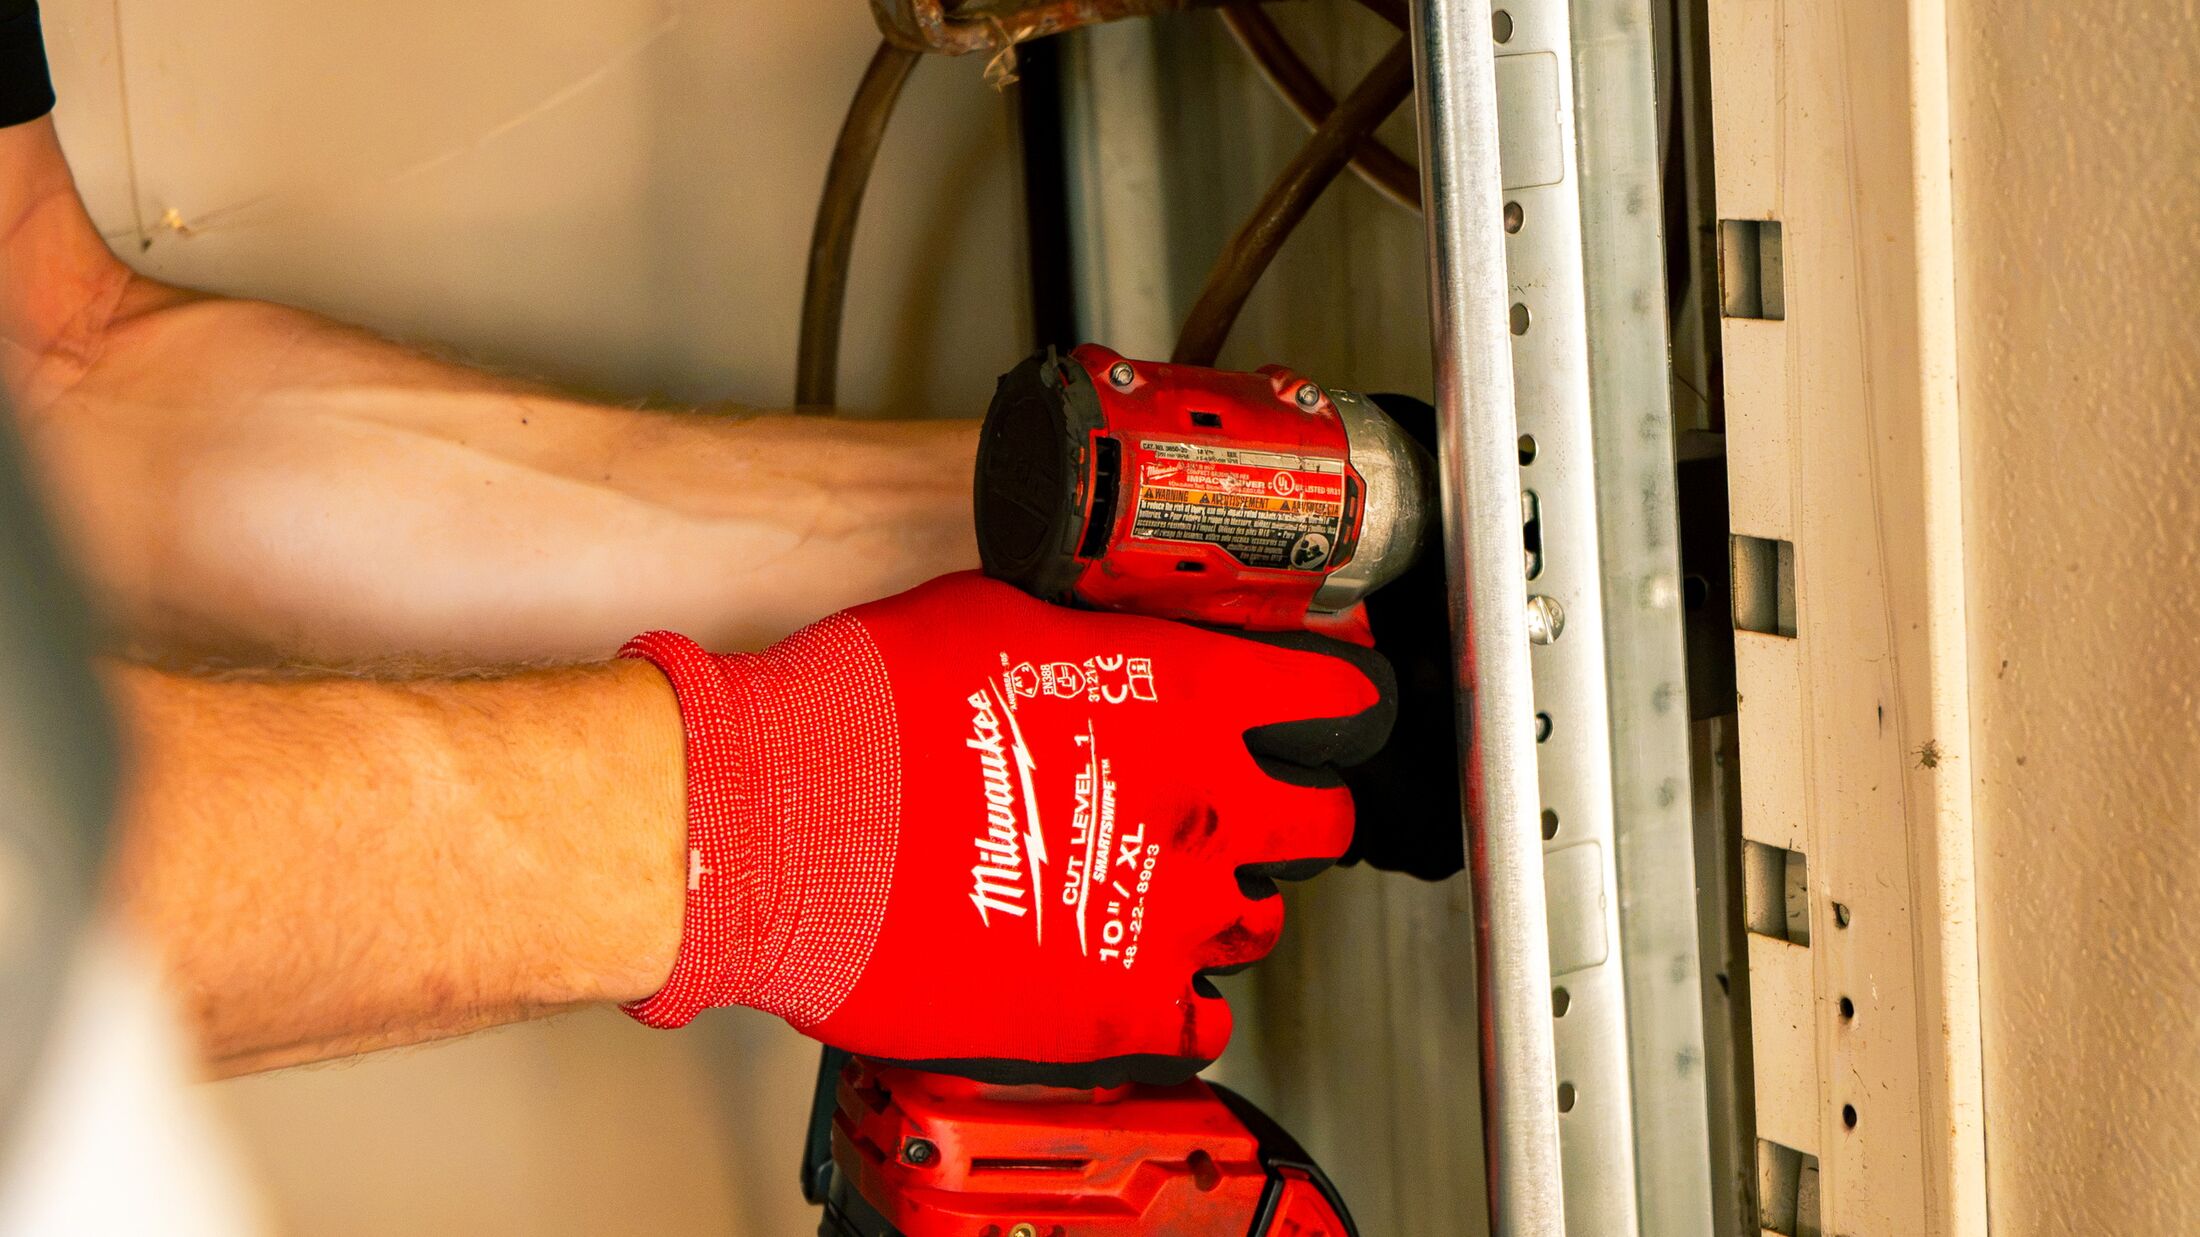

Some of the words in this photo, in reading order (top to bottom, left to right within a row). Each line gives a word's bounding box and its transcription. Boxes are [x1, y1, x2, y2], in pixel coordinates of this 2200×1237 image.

[1154, 488, 1188, 502] WARNING
[1186, 474, 1225, 485] IMPAC
[1278, 476, 1290, 491] UL
[1040, 664, 1054, 695] EN388
[1094, 653, 1128, 705] CE
[1074, 734, 1090, 748] 1
[966, 688, 1028, 929] Milwaukee
[1071, 763, 1092, 845] LEVEL
[1114, 822, 1145, 870] XL
[1062, 856, 1084, 906] CUT
[1122, 843, 1160, 970] 48-22-8903
